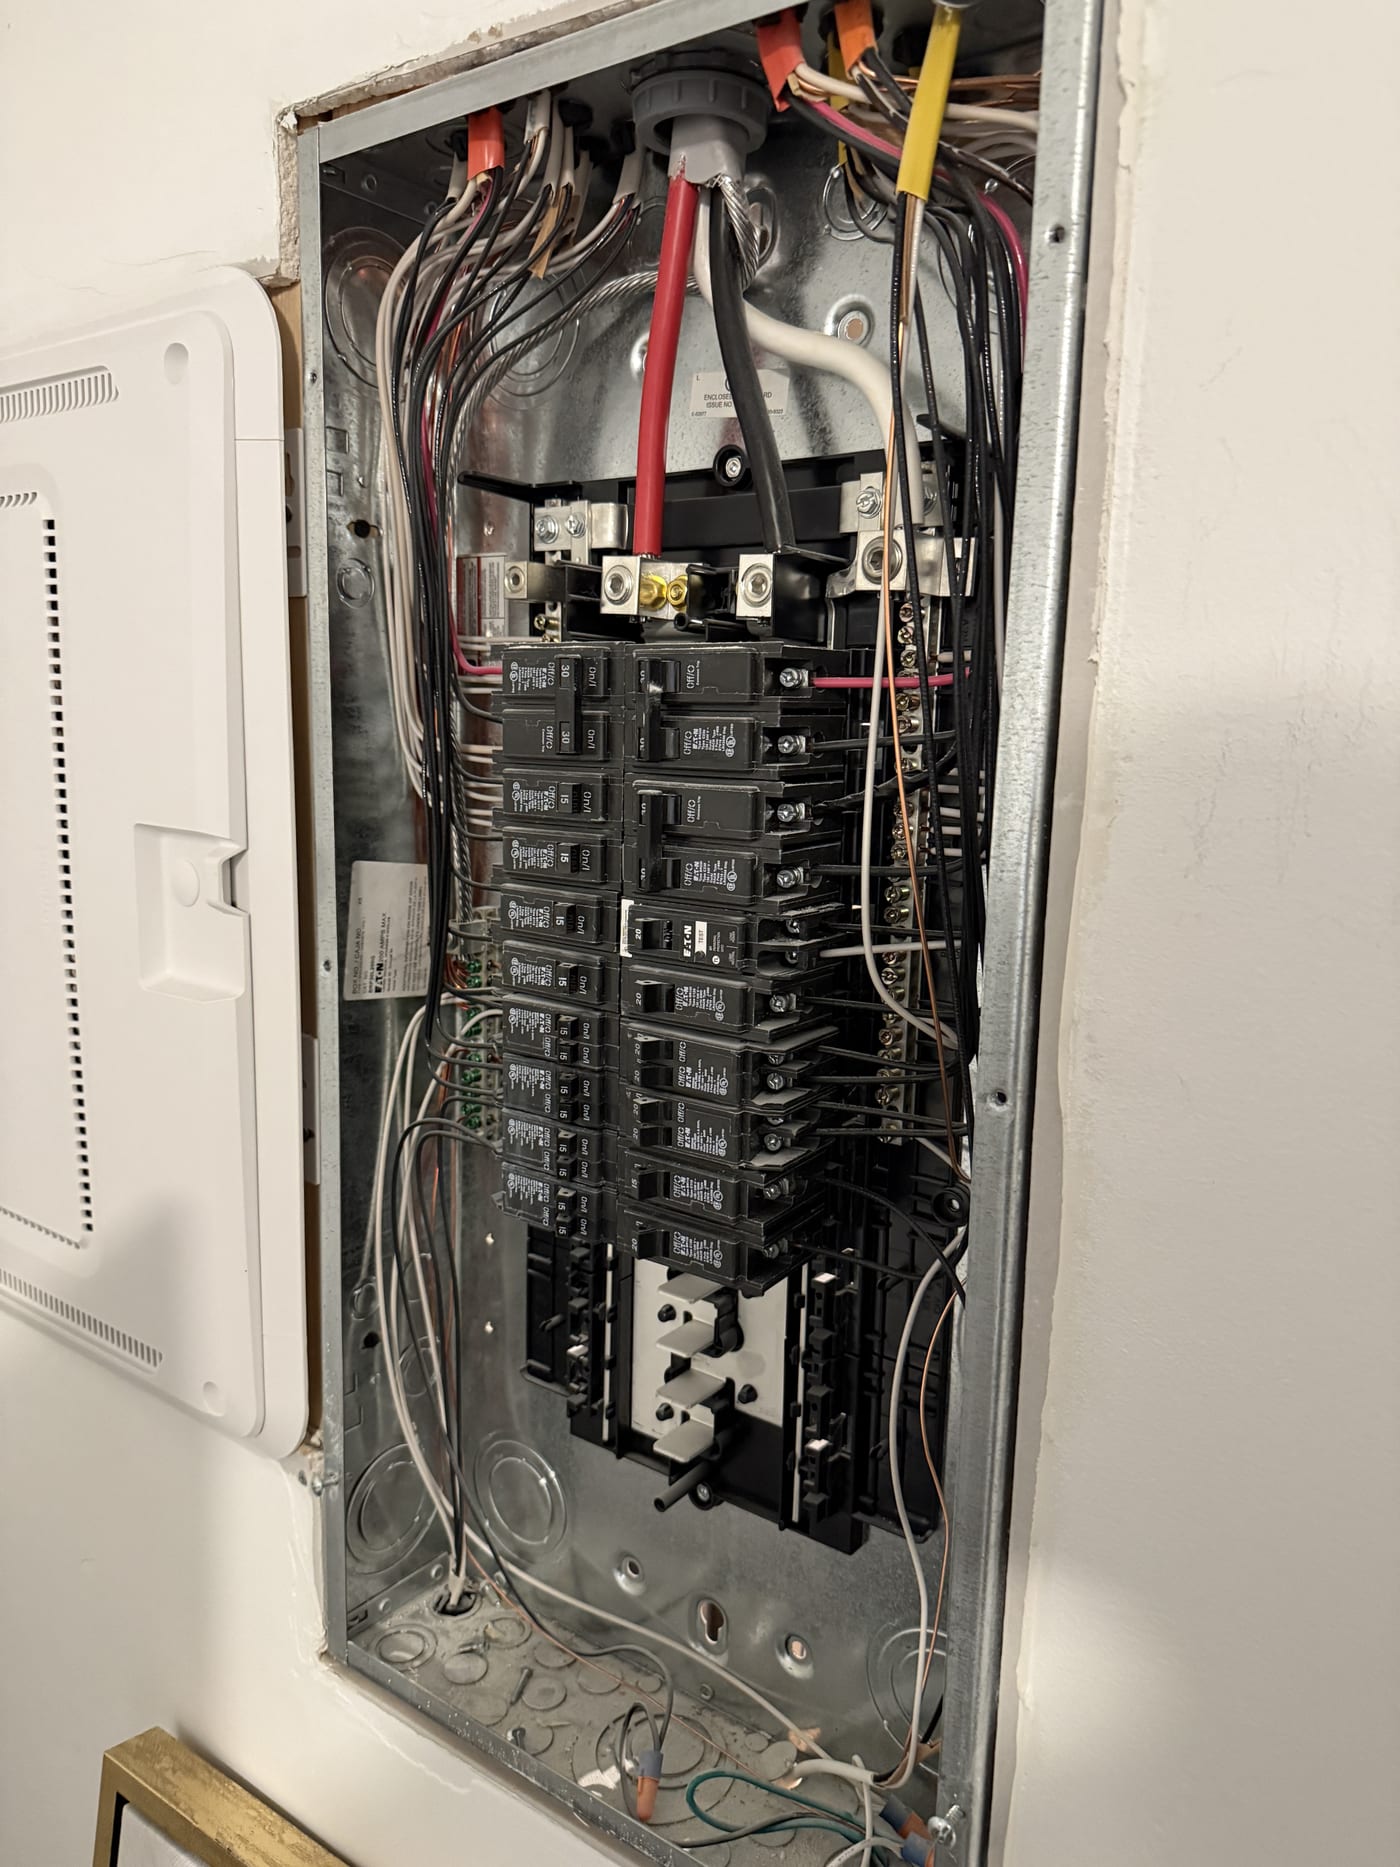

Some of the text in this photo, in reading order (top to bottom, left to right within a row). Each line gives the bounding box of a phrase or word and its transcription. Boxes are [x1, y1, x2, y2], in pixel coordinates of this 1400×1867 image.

[561, 665, 570, 678] 30
[561, 731, 570, 744] 30
[561, 794, 569, 804] 15
[560, 853, 569, 863] 15
[556, 916, 565, 926] 15
[635, 928, 642, 940] 20
[558, 977, 567, 987] 15
[635, 992, 642, 1006] 20
[560, 1027, 568, 1036] 15
[635, 1043, 640, 1056] 20
[560, 1052, 568, 1060] 15
[634, 1070, 640, 1082] 20
[560, 1086, 569, 1094] 15
[560, 1110, 568, 1119] 15
[633, 1104, 639, 1116] 20
[633, 1128, 638, 1140] 20
[560, 1144, 567, 1152] 15
[559, 1168, 567, 1177] 15
[558, 1202, 566, 1211] 15
[559, 1227, 566, 1235] 15
[632, 1238, 638, 1251] 20
